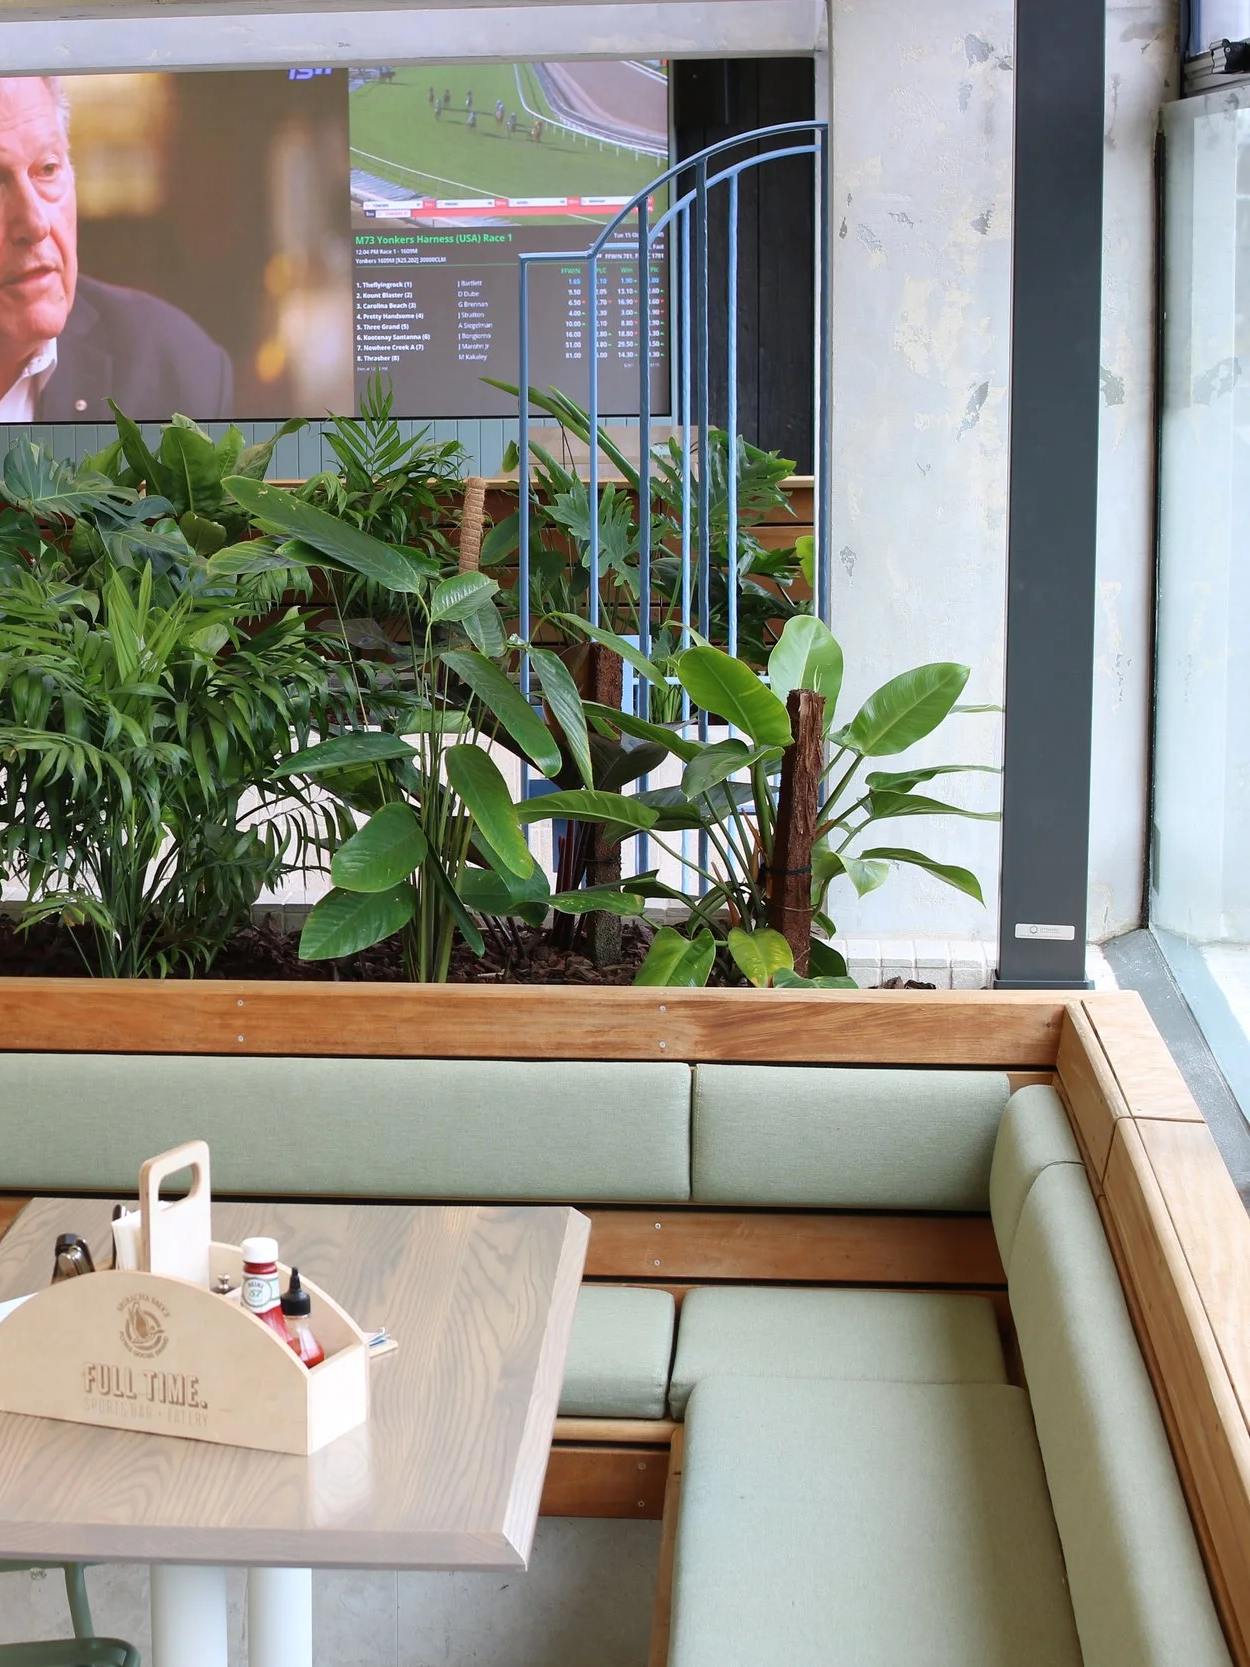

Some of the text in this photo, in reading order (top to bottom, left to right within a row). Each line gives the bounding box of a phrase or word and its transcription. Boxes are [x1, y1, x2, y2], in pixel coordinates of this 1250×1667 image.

[355, 233, 513, 245] M73 Yonkers Harness (USA) Race 1
[363, 302, 388, 310] Carolina
[363, 313, 382, 321] Pretty
[383, 312, 415, 320] Handsome
[363, 323, 381, 331] Three
[83, 1362, 208, 1409] FULL TIME.
[132, 1402, 151, 1419] BAR
